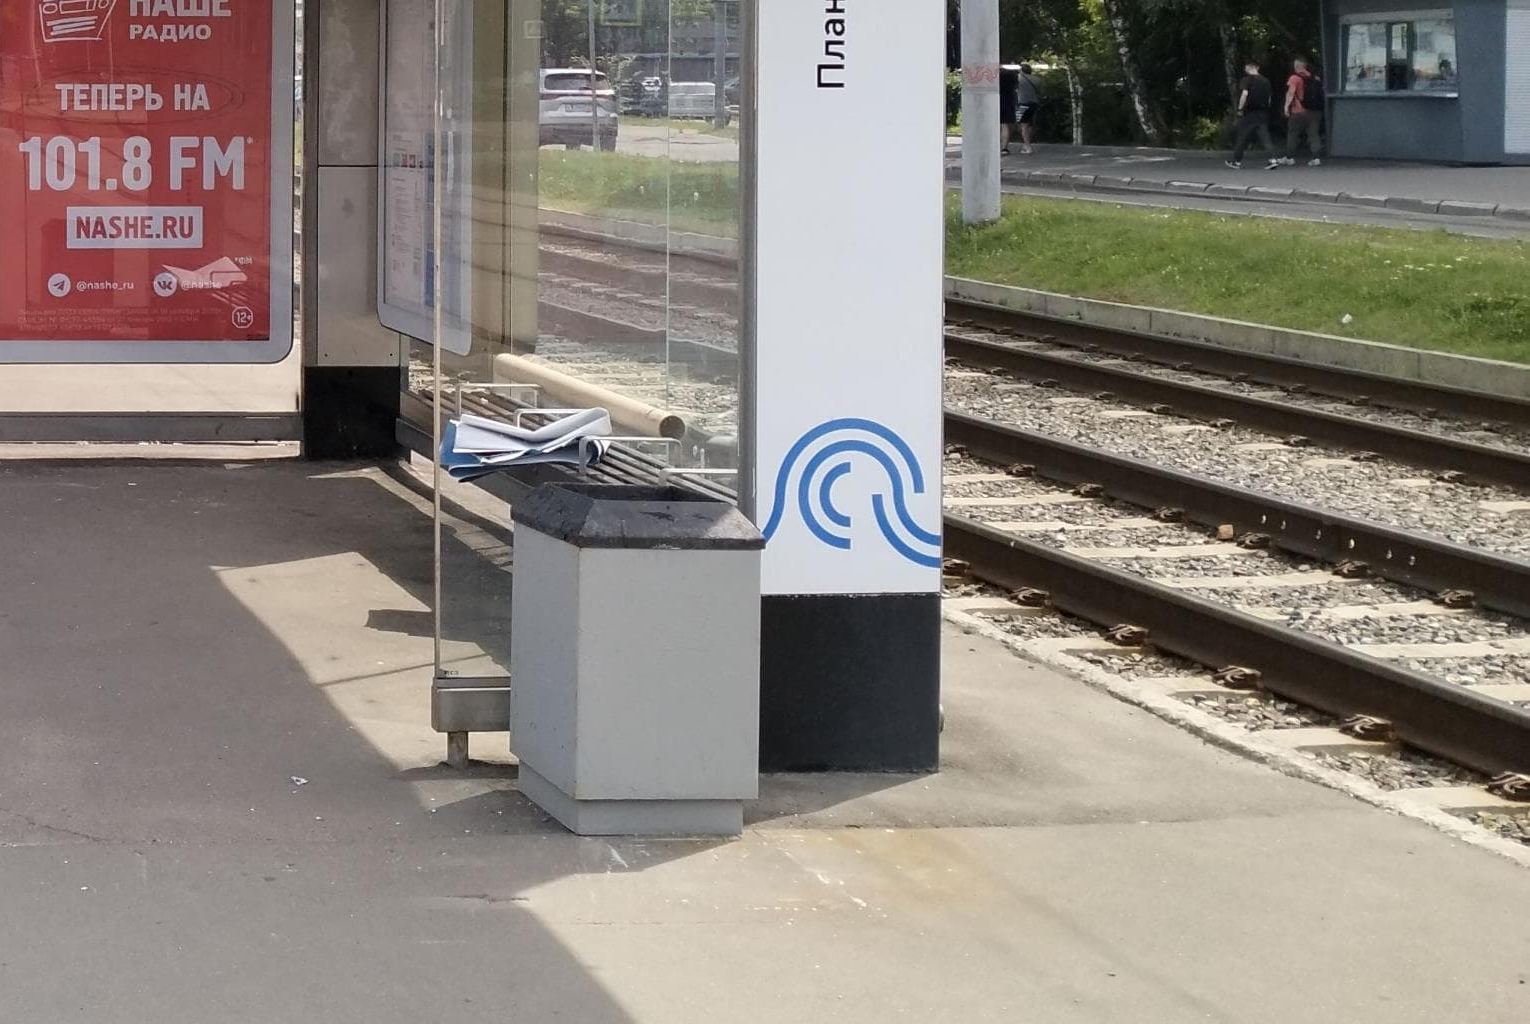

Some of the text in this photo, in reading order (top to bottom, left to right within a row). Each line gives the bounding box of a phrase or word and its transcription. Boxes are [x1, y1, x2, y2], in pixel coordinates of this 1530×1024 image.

[129, 24, 212, 42] РАДИО
[55, 83, 211, 111] ТЕПЕРЬ НА
[19, 135, 152, 191] 101.8
[76, 215, 194, 240] NASHE.RU
[76, 280, 135, 292] @nashe_ru
[235, 311, 252, 324] 12+
